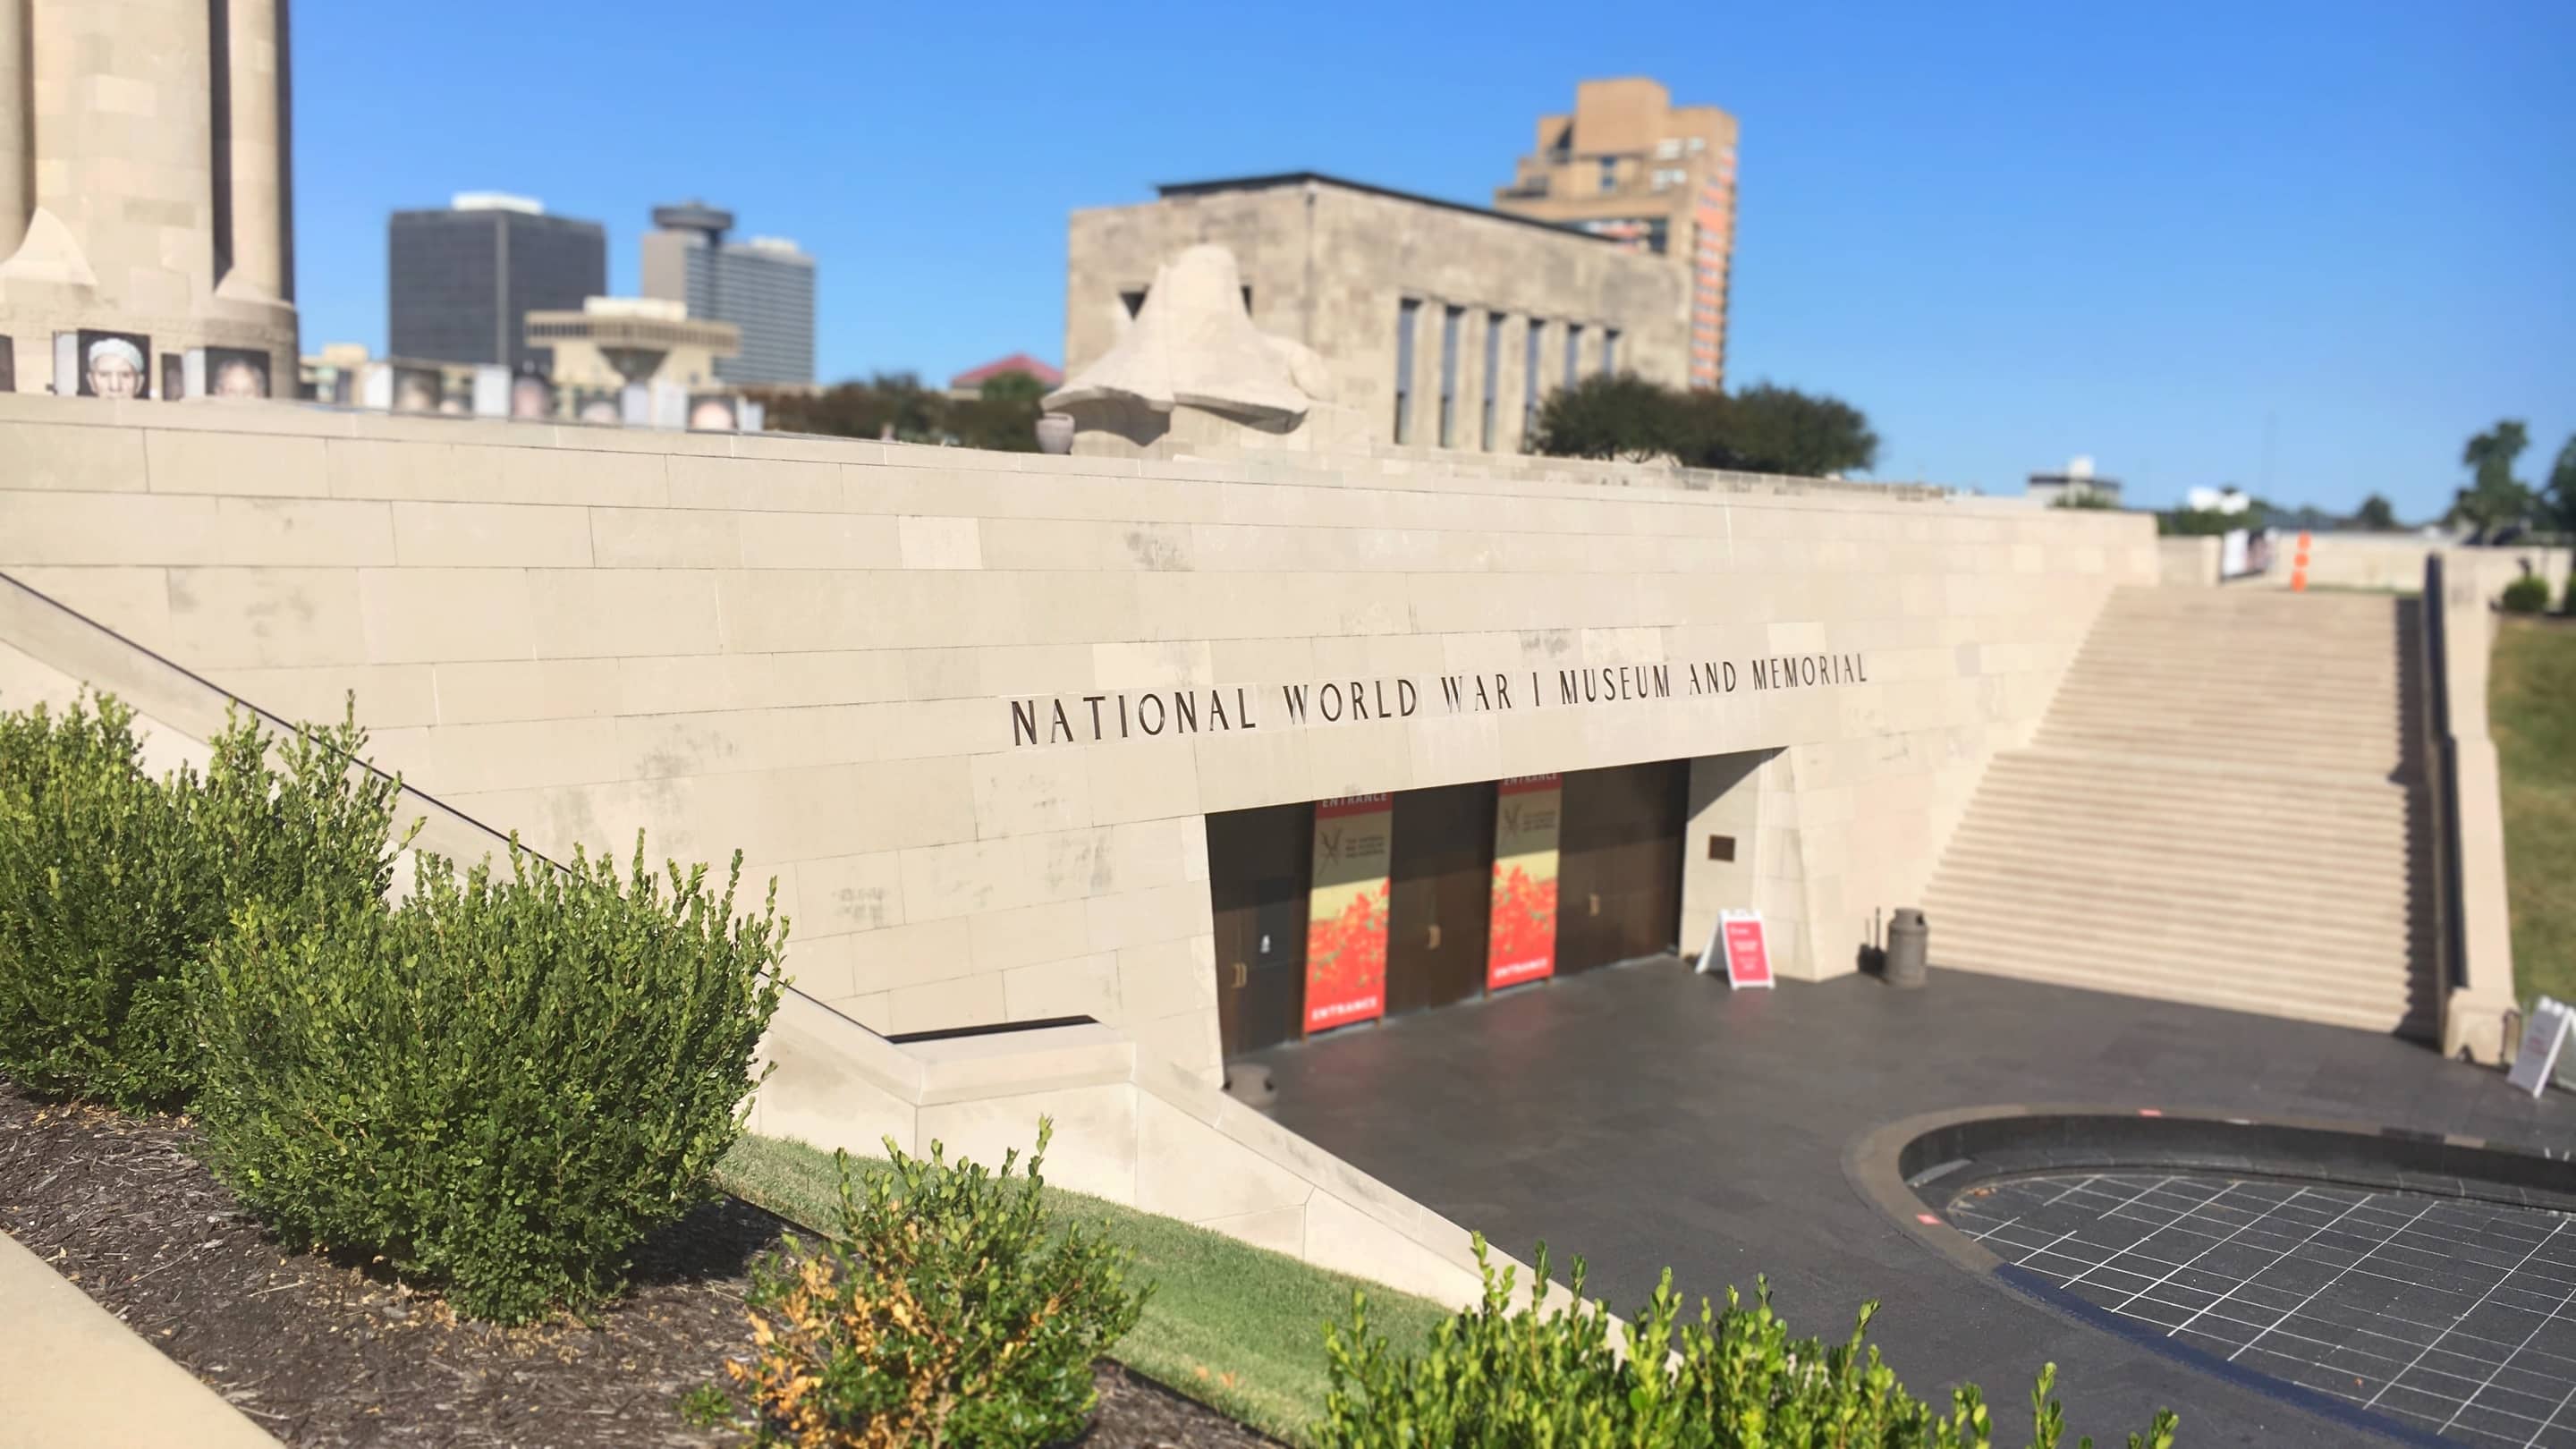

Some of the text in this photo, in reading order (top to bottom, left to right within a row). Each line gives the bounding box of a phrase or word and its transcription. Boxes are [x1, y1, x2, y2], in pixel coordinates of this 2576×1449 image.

[1011, 653, 1868, 746] NATIONAL WORLD WAR I MUSEUM AND MEMORIAL
[1322, 793, 1387, 808] ENTRANCE
